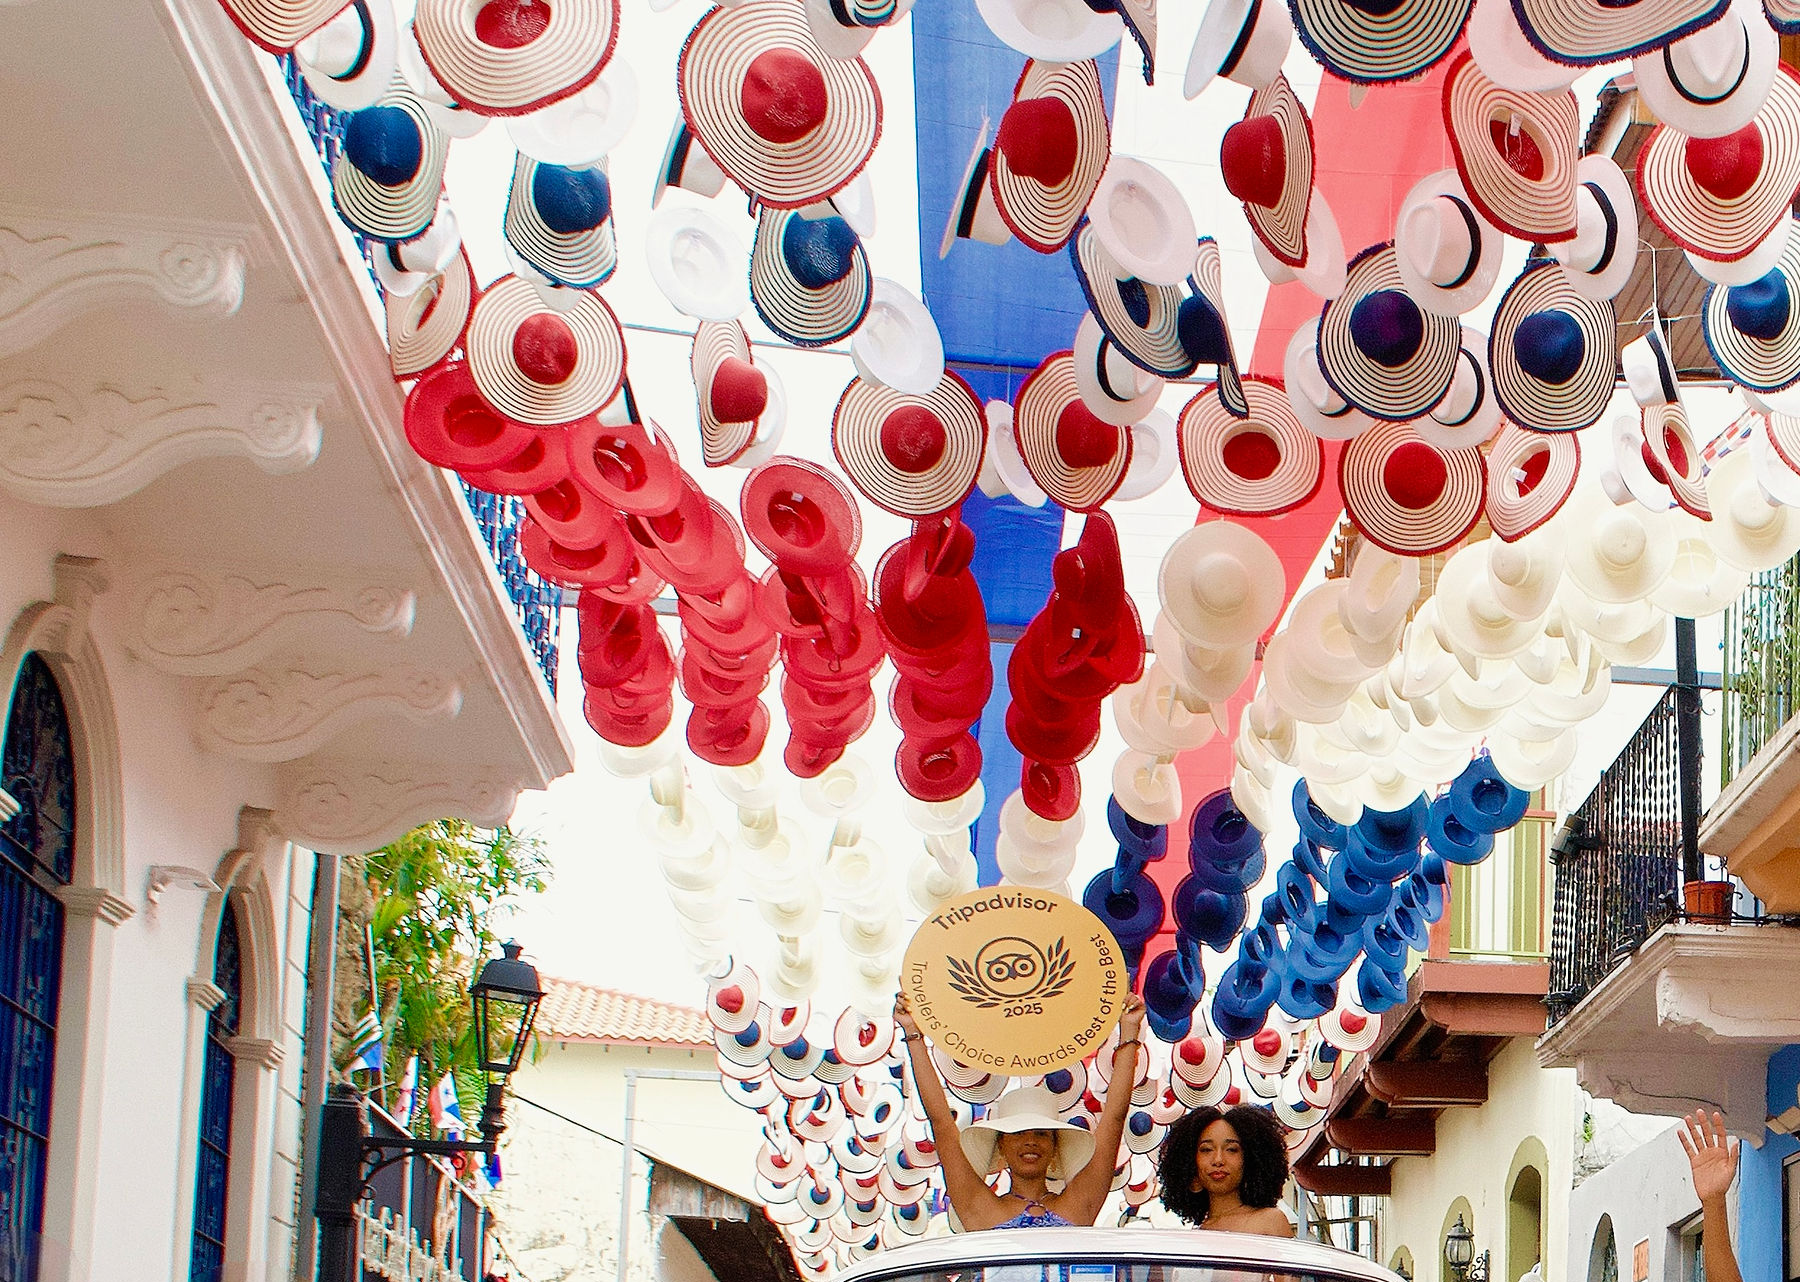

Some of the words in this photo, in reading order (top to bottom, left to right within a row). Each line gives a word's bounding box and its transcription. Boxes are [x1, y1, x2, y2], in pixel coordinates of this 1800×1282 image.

[931, 892, 1058, 931] Tripadvisor
[1089, 933, 1114, 967] Best
[1103, 970, 1117, 997] the
[1003, 1002, 1043, 1018] 2025
[1100, 997, 1114, 1015] of
[1073, 1016, 1105, 1047] Best
[944, 1031, 1005, 1067] Choice
[1010, 1043, 1077, 1069] Awards
